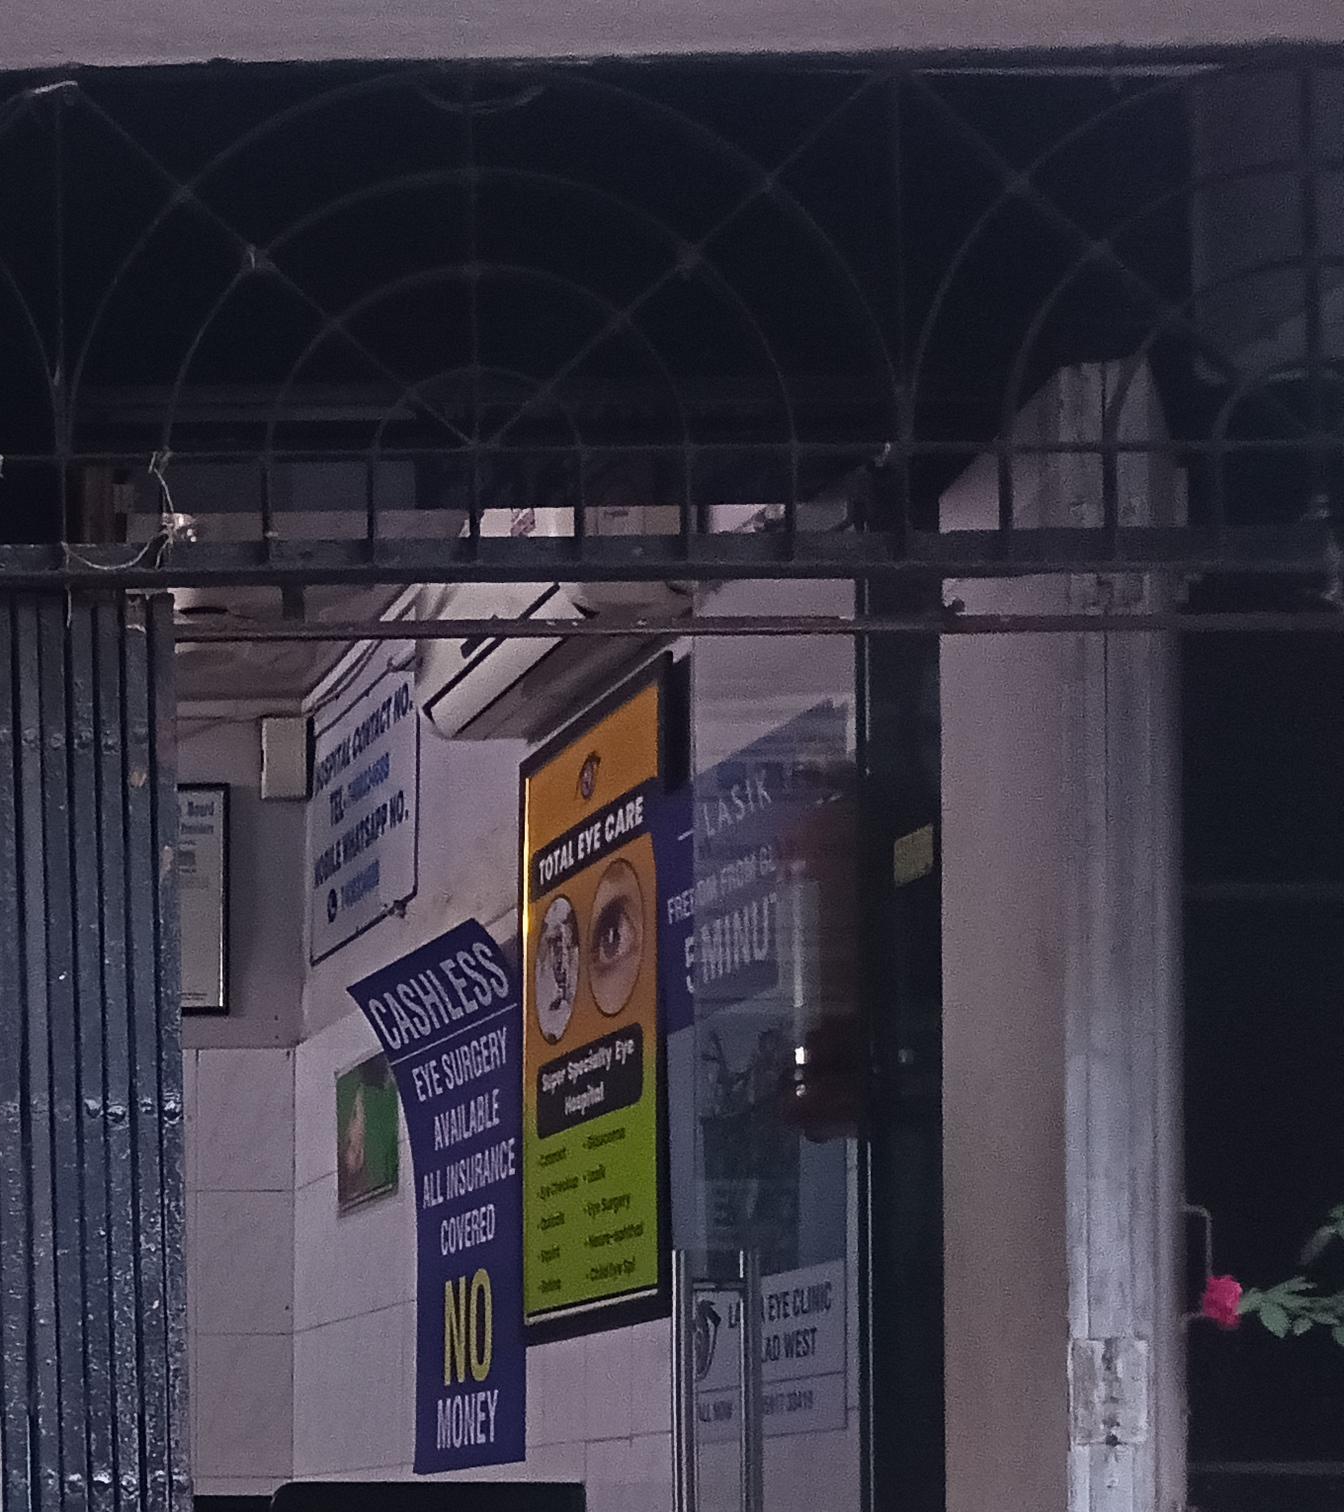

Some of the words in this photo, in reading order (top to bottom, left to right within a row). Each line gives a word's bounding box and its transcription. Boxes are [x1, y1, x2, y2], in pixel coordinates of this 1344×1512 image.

[538, 839, 574, 885] TOTAL
[577, 821, 601, 860] EYE
[605, 796, 643, 843] CARE
[701, 892, 777, 985] MINU
[368, 942, 509, 1050] CASHLESS
[412, 1060, 443, 1102] EYE
[442, 1026, 507, 1090] SURGERY
[615, 1039, 634, 1065] Eye
[434, 1088, 501, 1151] AVAILABLE
[422, 1171, 444, 1209] ALL
[446, 1137, 516, 1200] INSURANCE
[440, 1203, 496, 1256] COVERED
[444, 1268, 493, 1387] NO
[768, 1290, 791, 1323] EYE
[783, 1326, 818, 1360] WEST
[437, 1389, 499, 1451] MONEY
